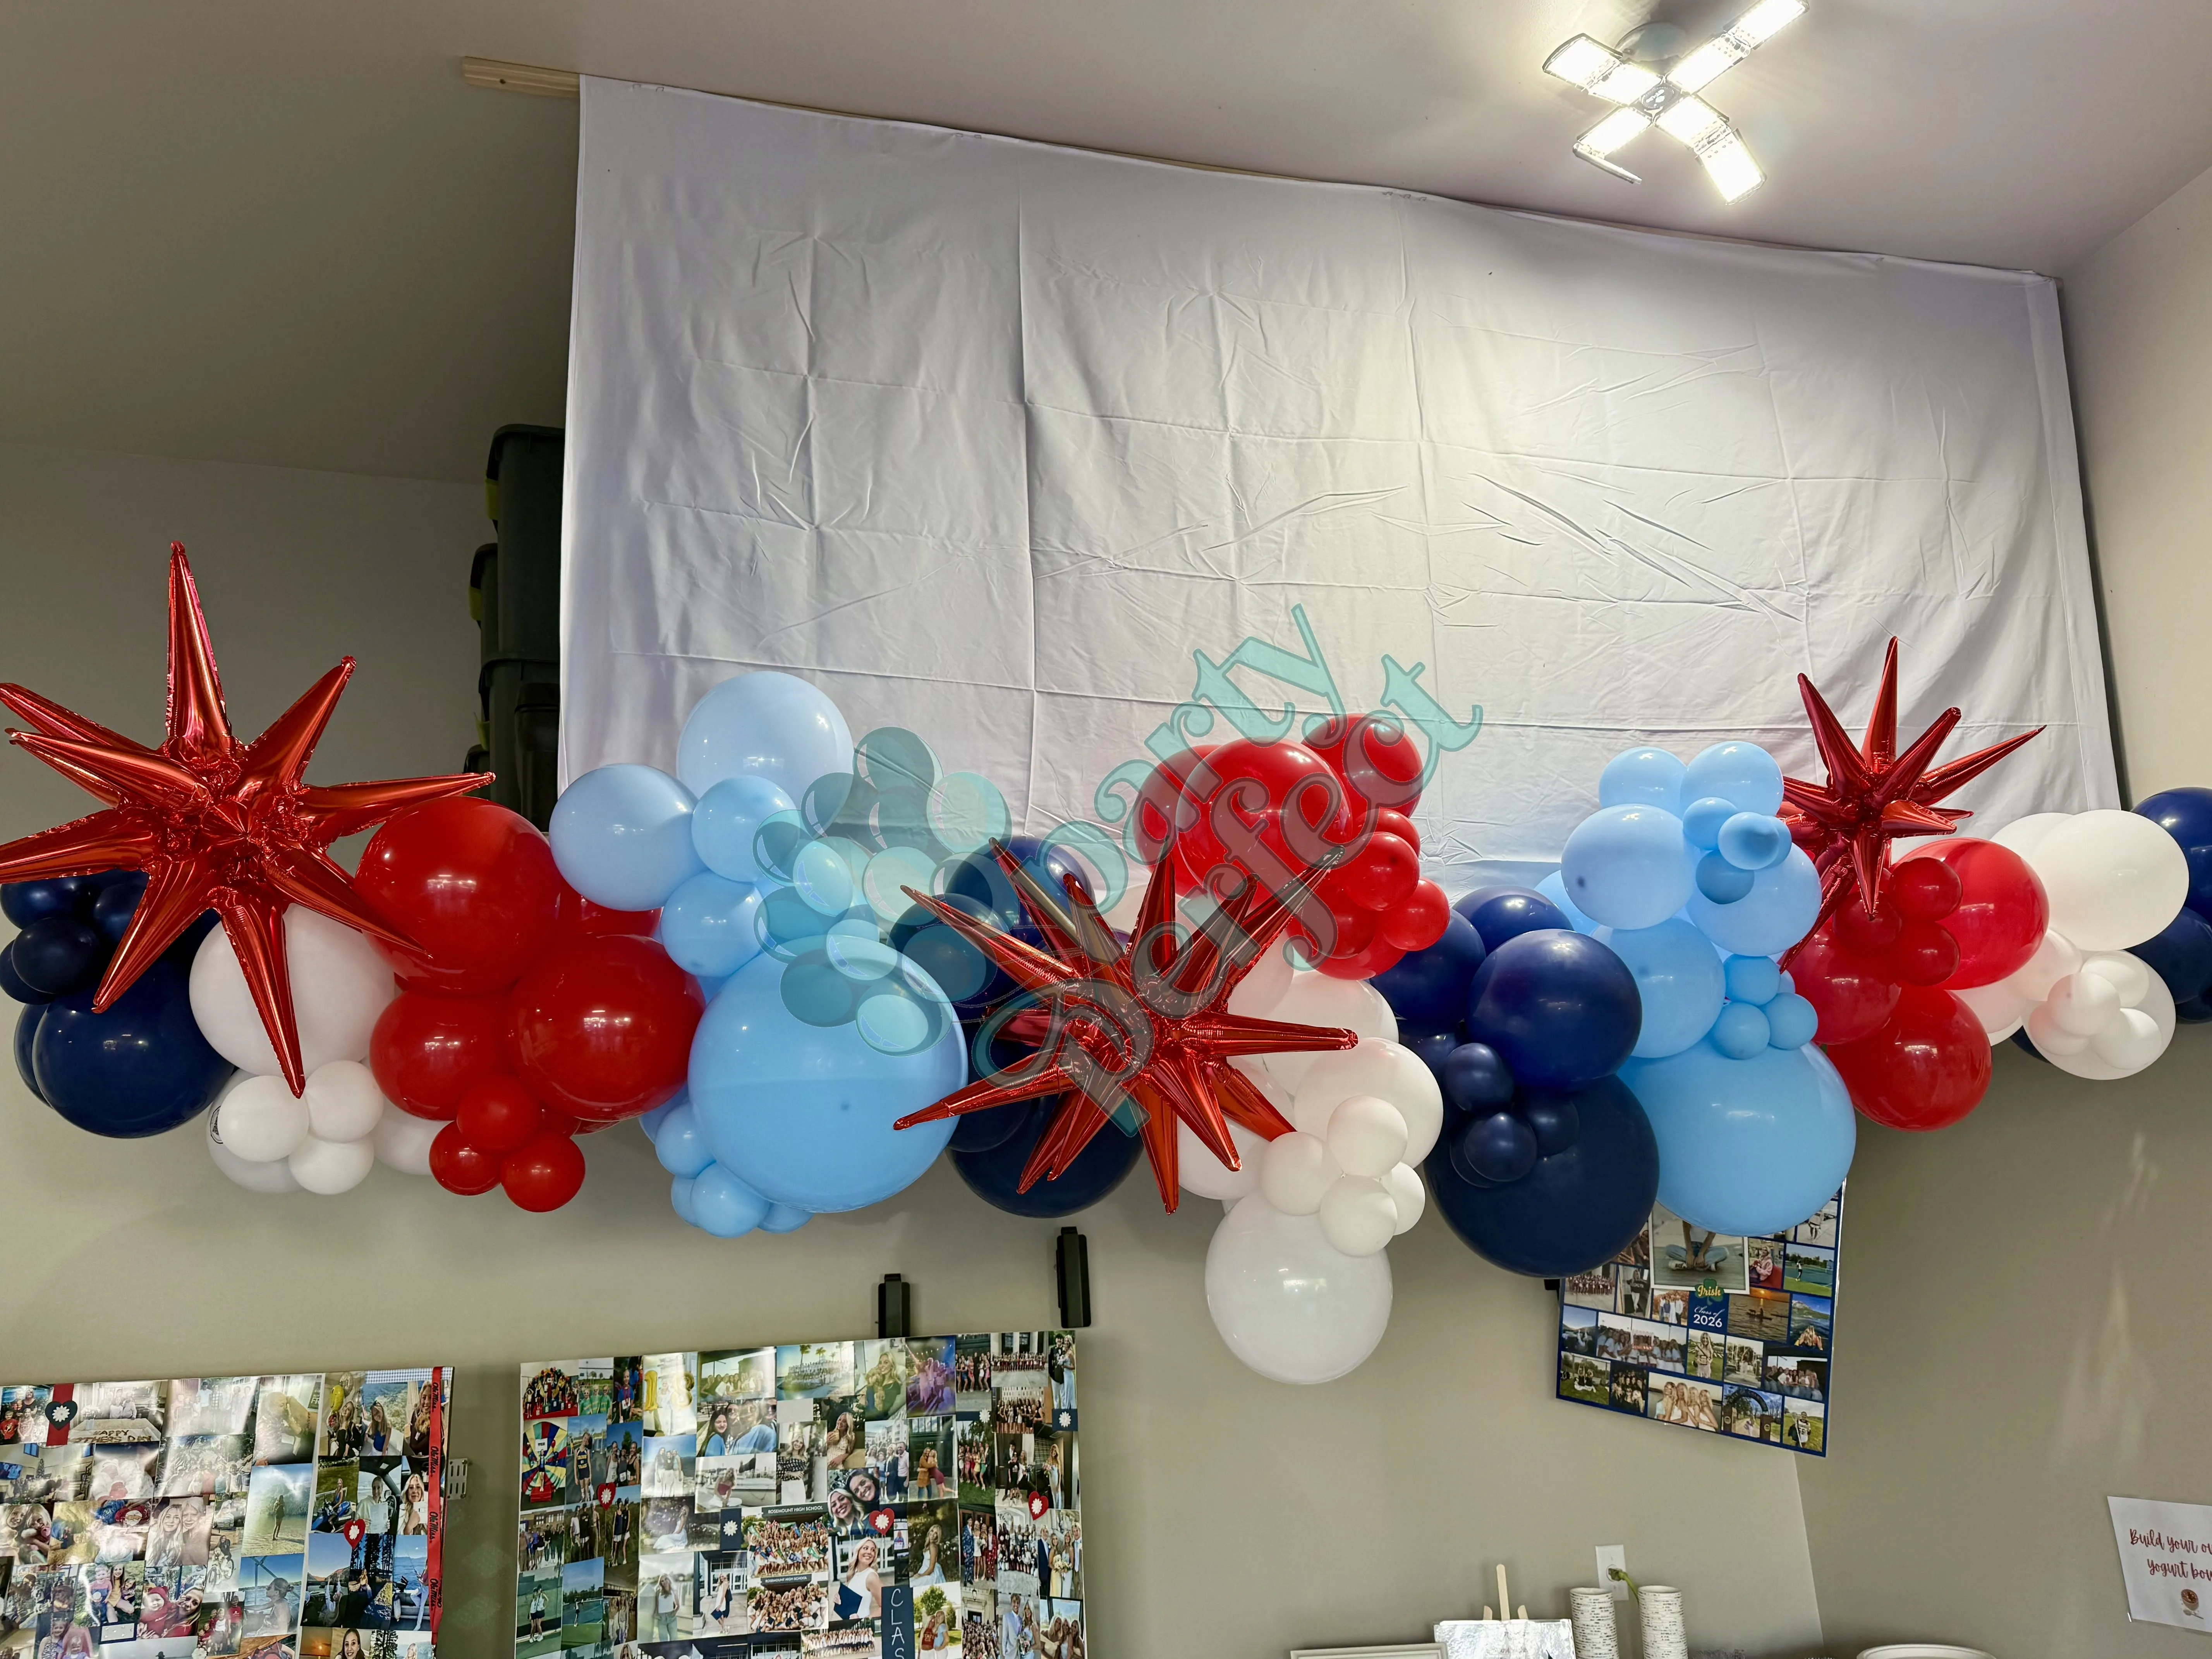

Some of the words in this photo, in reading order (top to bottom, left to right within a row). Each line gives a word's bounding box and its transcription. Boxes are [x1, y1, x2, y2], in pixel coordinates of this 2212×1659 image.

[1697, 1285, 1721, 1297] Irish
[1694, 1305, 1711, 1315] Class
[1693, 1314, 1723, 1328] 2026
[2130, 1528, 2165, 1550] Build
[2167, 1536, 2198, 1554] your
